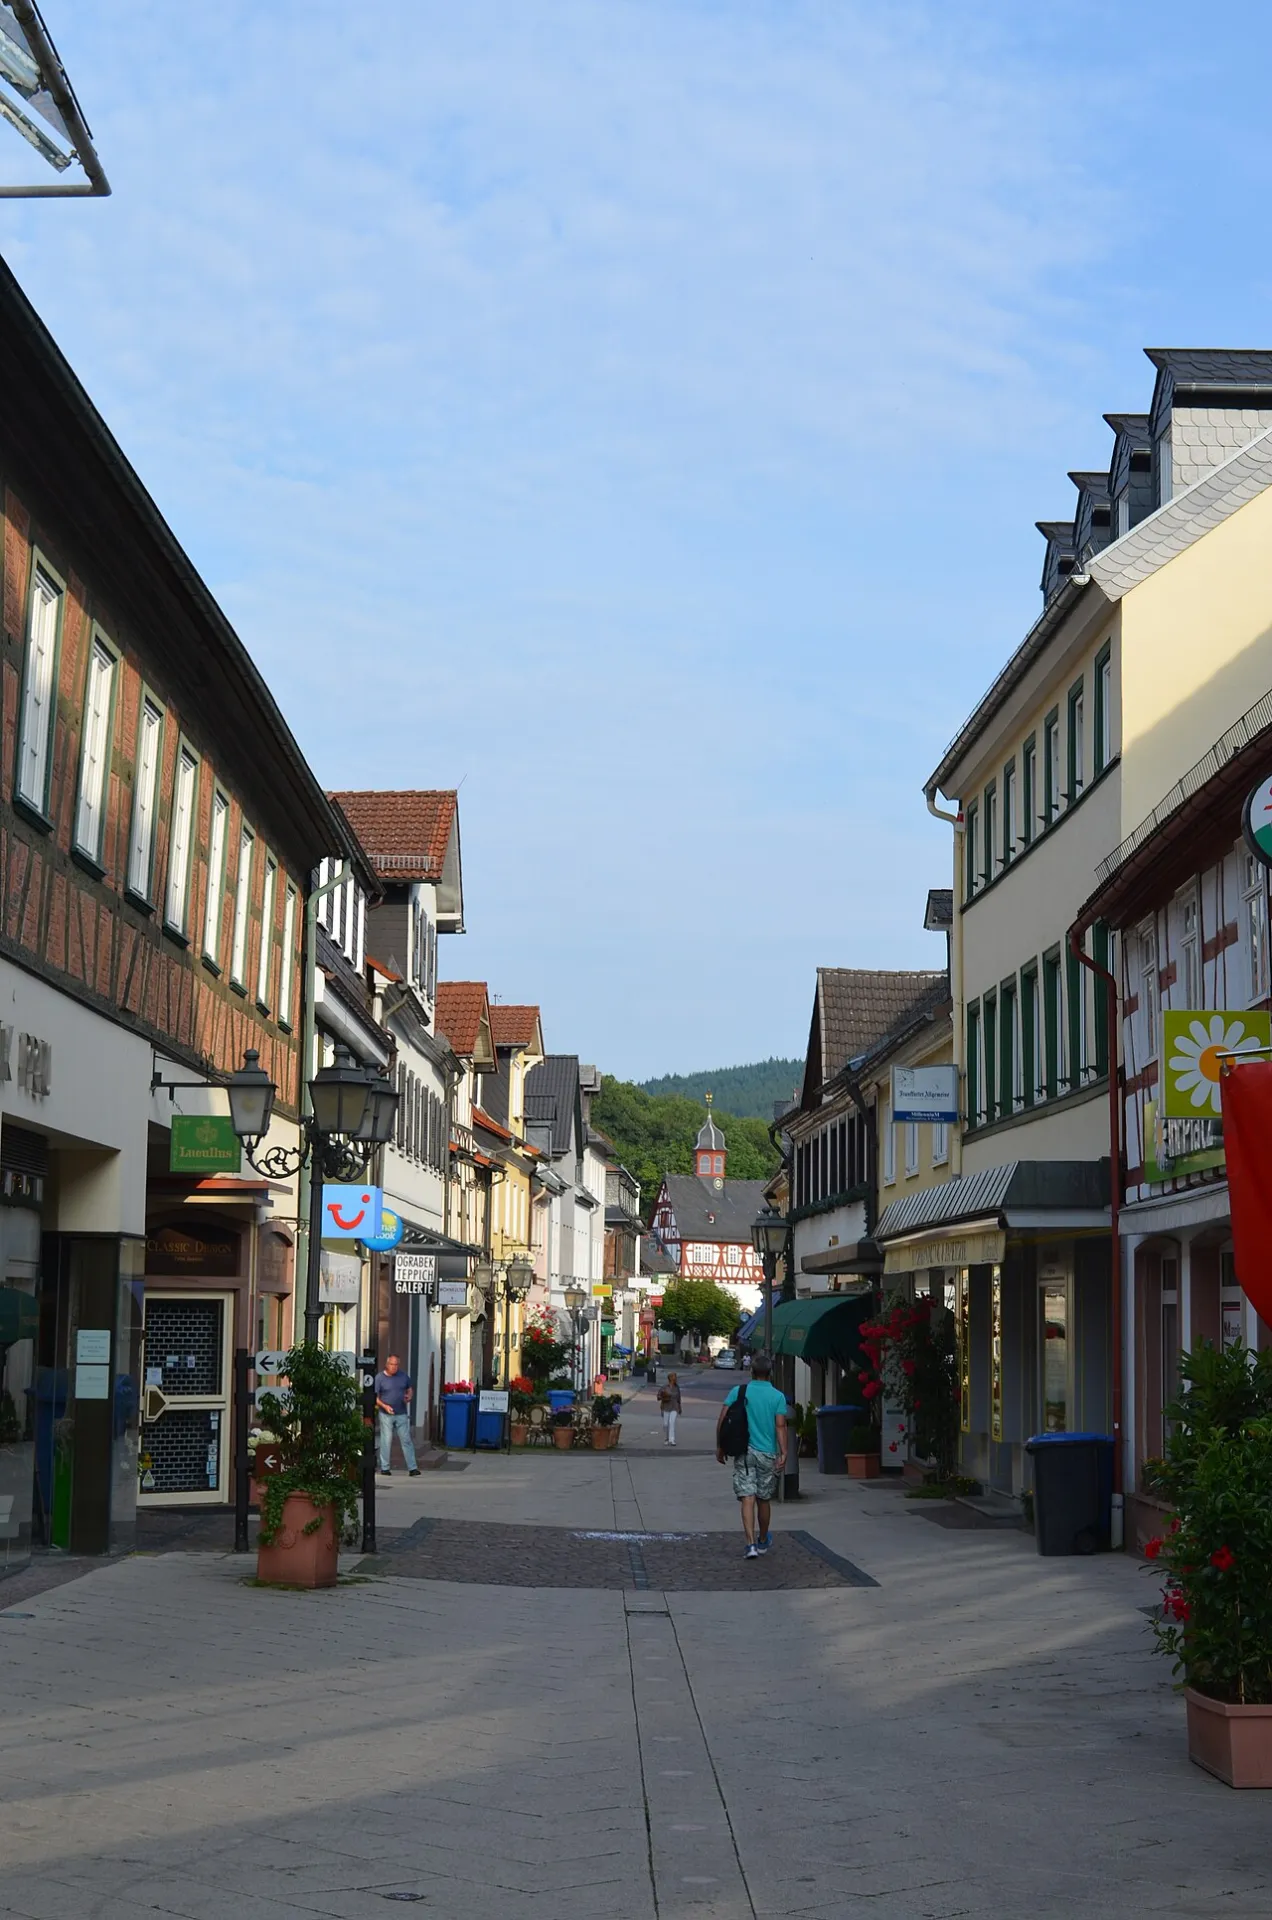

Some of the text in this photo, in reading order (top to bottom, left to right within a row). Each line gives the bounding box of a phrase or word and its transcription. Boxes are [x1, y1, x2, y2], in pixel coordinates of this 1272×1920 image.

[924, 1090, 950, 1098] Allgemeine
[146, 1240, 190, 1253] CLASSIC
[397, 1255, 434, 1268] OGRABEK
[396, 1269, 434, 1281] TEPPICH
[395, 1281, 433, 1294] GALERIE
